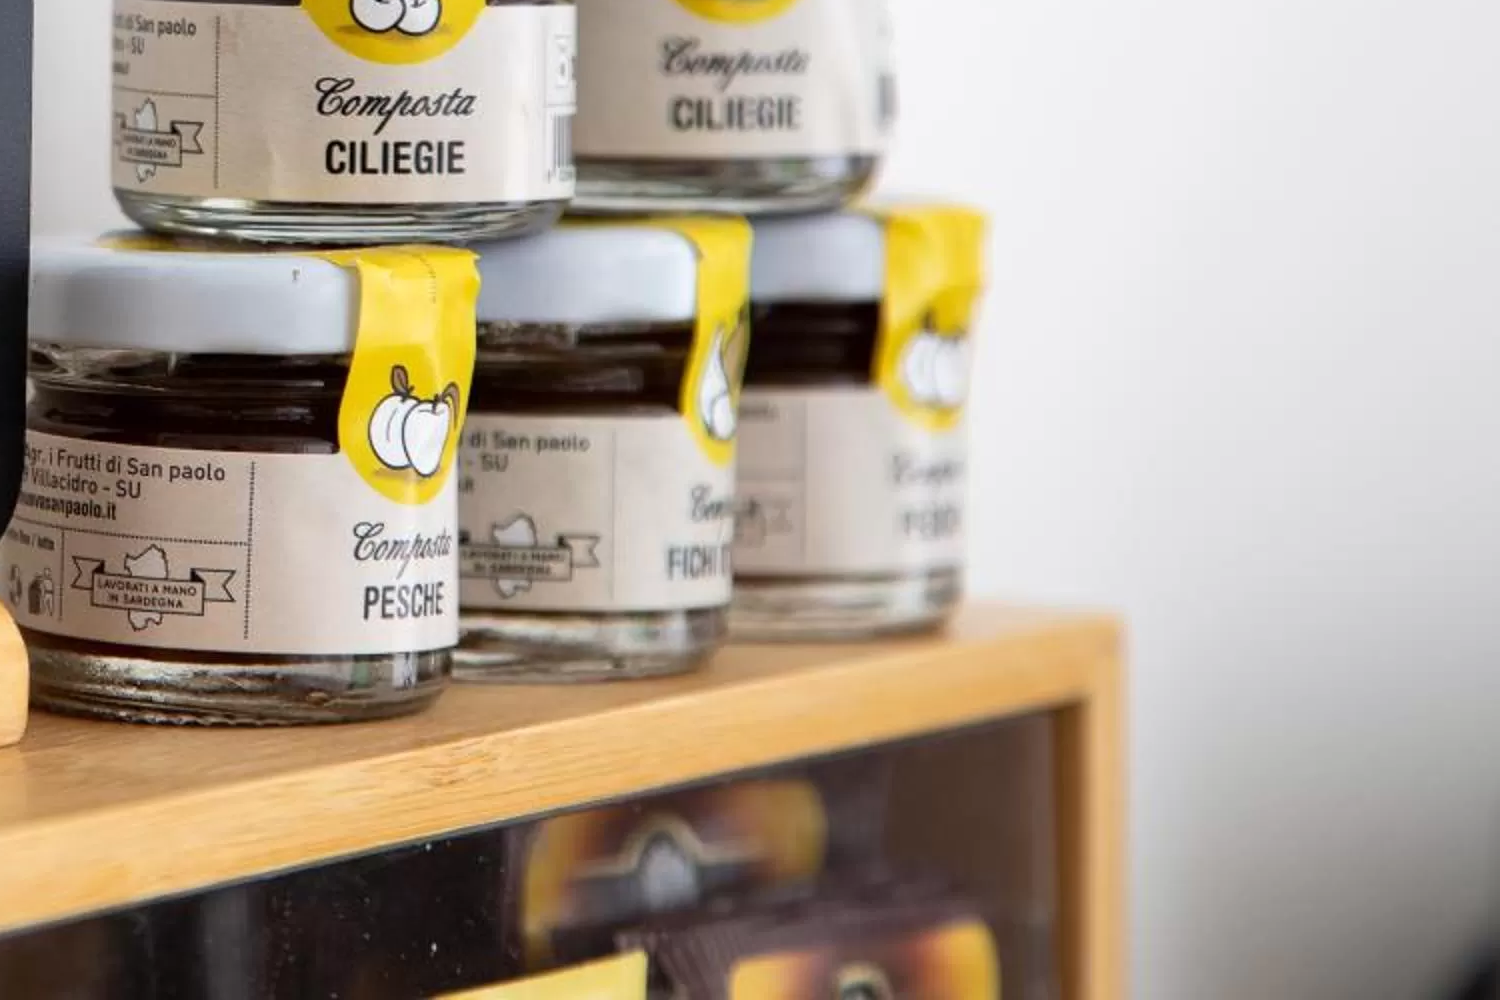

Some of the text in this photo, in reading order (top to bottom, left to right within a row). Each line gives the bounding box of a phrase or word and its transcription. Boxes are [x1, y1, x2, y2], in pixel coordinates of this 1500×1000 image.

[157, 17, 197, 38] paolo
[660, 35, 810, 92] Composta
[315, 77, 477, 136] Composta
[670, 97, 802, 131] CILIEGIE
[325, 139, 465, 175] CILIEGIE
[537, 433, 592, 455] paolo
[31, 465, 98, 494] Villacidro
[115, 480, 141, 499] SU
[58, 449, 101, 471] Frutti
[105, 456, 121, 475] di
[127, 458, 163, 478] San
[169, 462, 225, 485] paolo
[353, 521, 452, 580] Composta
[163, 584, 197, 597] MANO
[364, 581, 444, 620] PESCHE
